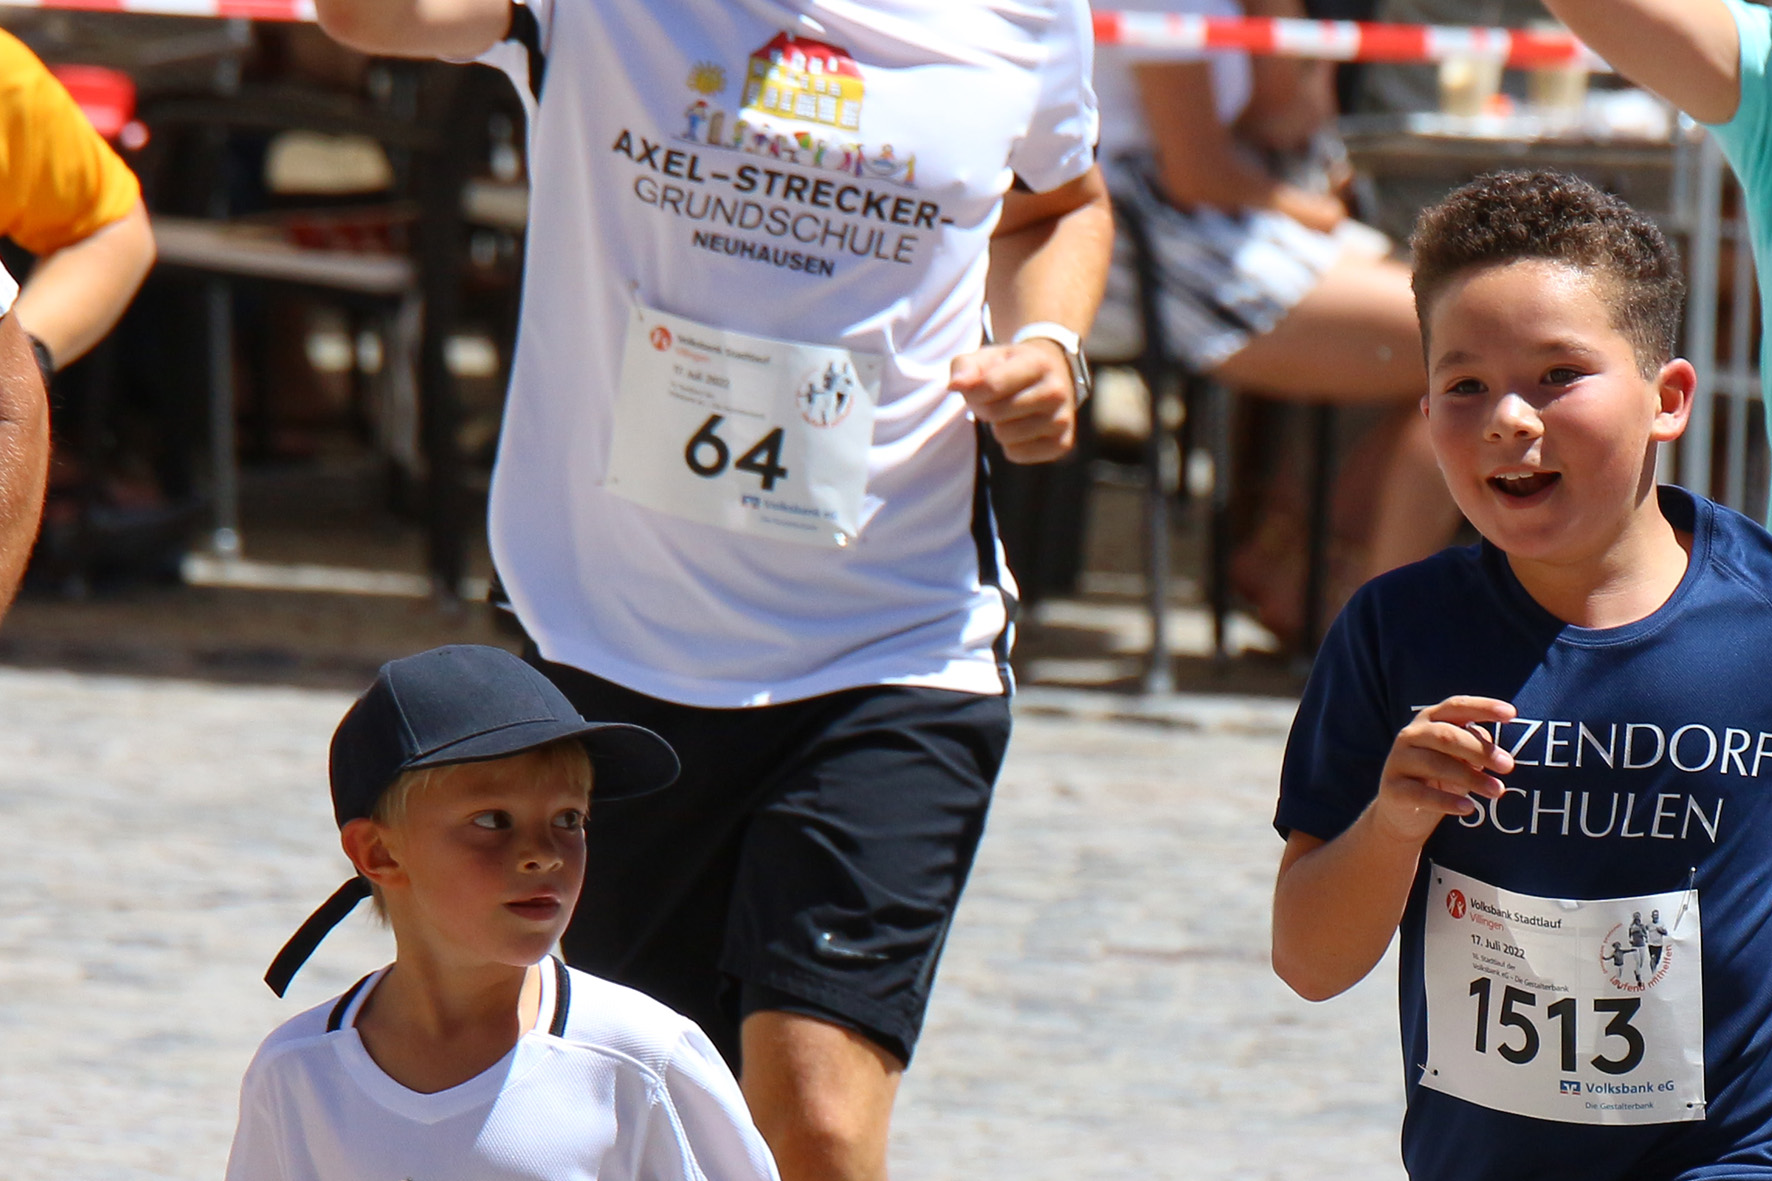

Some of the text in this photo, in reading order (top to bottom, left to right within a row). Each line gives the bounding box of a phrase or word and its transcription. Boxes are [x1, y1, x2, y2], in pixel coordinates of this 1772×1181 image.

[633, 175, 919, 264] GRUNDSCHULE
[692, 230, 836, 278] NEUHAUSEN
[684, 414, 787, 491] 64
[1458, 787, 1724, 843] SCHULEN
[1470, 898, 1562, 929] Volksbank Stadtlauf
[1470, 911, 1504, 932] Villingen
[1471, 934, 1526, 959] 17. Juli 2022
[1609, 975, 1646, 992] laufend
[1647, 944, 1673, 988] mithelfen
[1468, 976, 1646, 1075] 1513
[1585, 1080, 1675, 1094] Volksbank eG
[1585, 1101, 1654, 1110] Die Gestalterbank
